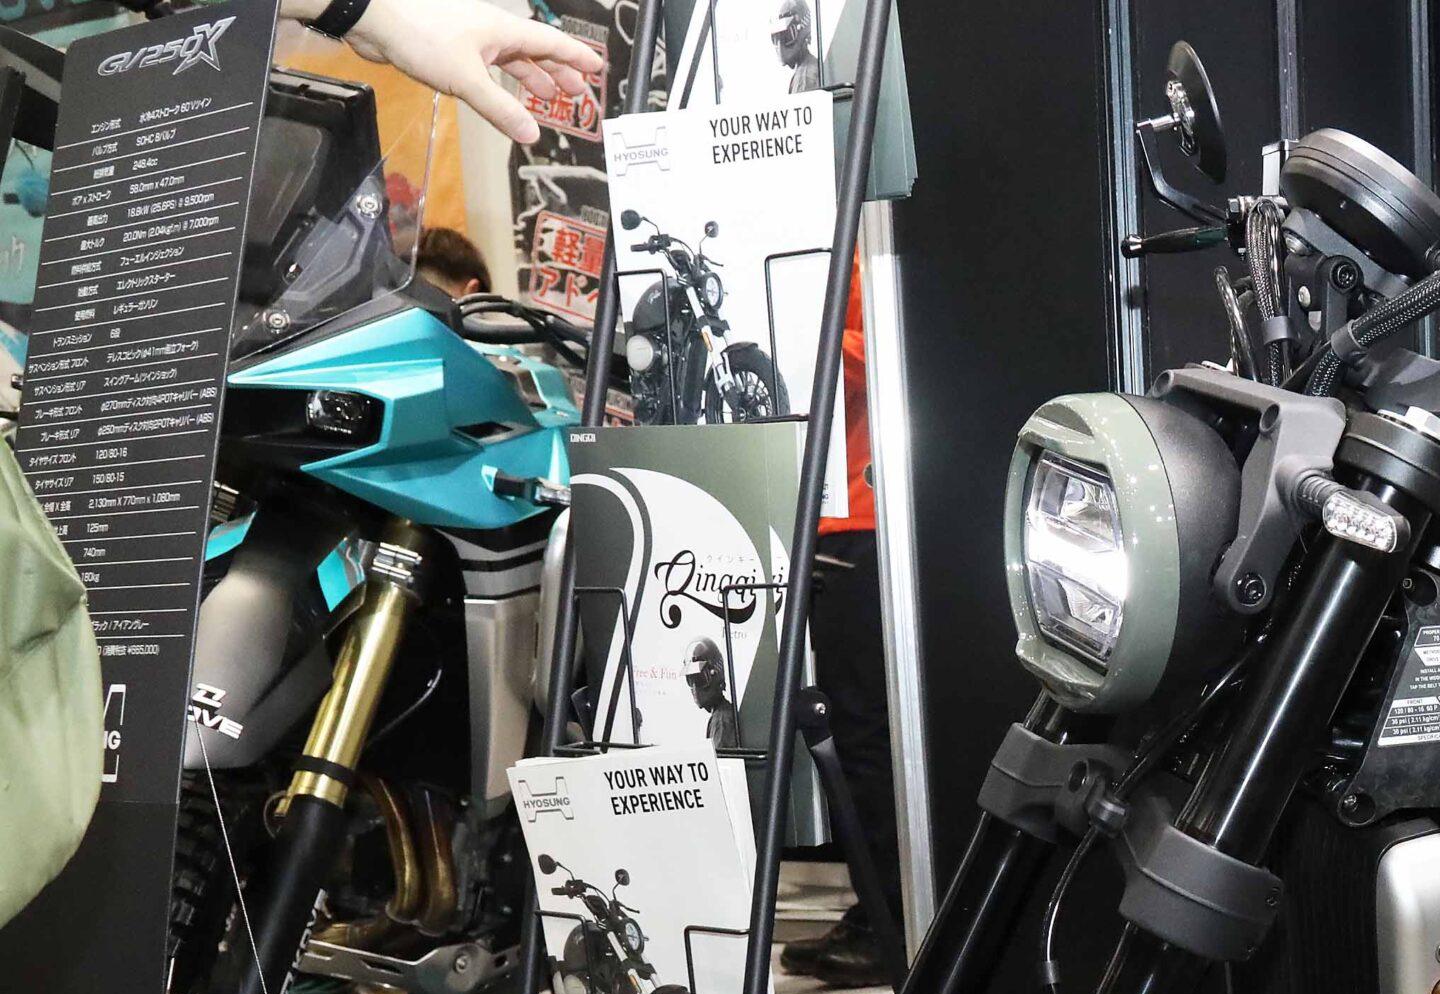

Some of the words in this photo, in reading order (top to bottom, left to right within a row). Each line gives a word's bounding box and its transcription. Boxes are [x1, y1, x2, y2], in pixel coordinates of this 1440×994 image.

[710, 115, 751, 138] YOUR
[755, 109, 789, 132] WAY
[794, 106, 812, 126] TO
[613, 148, 669, 163] HYOSUNG
[712, 134, 803, 164] EXPERIENCE
[132, 158, 158, 171] 248.4cc
[87, 522, 109, 534] 125mm
[83, 547, 106, 558] 740mm
[604, 768, 648, 790] YOUR
[649, 764, 684, 786] WAY
[687, 762, 709, 782] TO
[523, 797, 570, 809] HYOSUNG
[611, 789, 705, 816] EXPERIENCE
